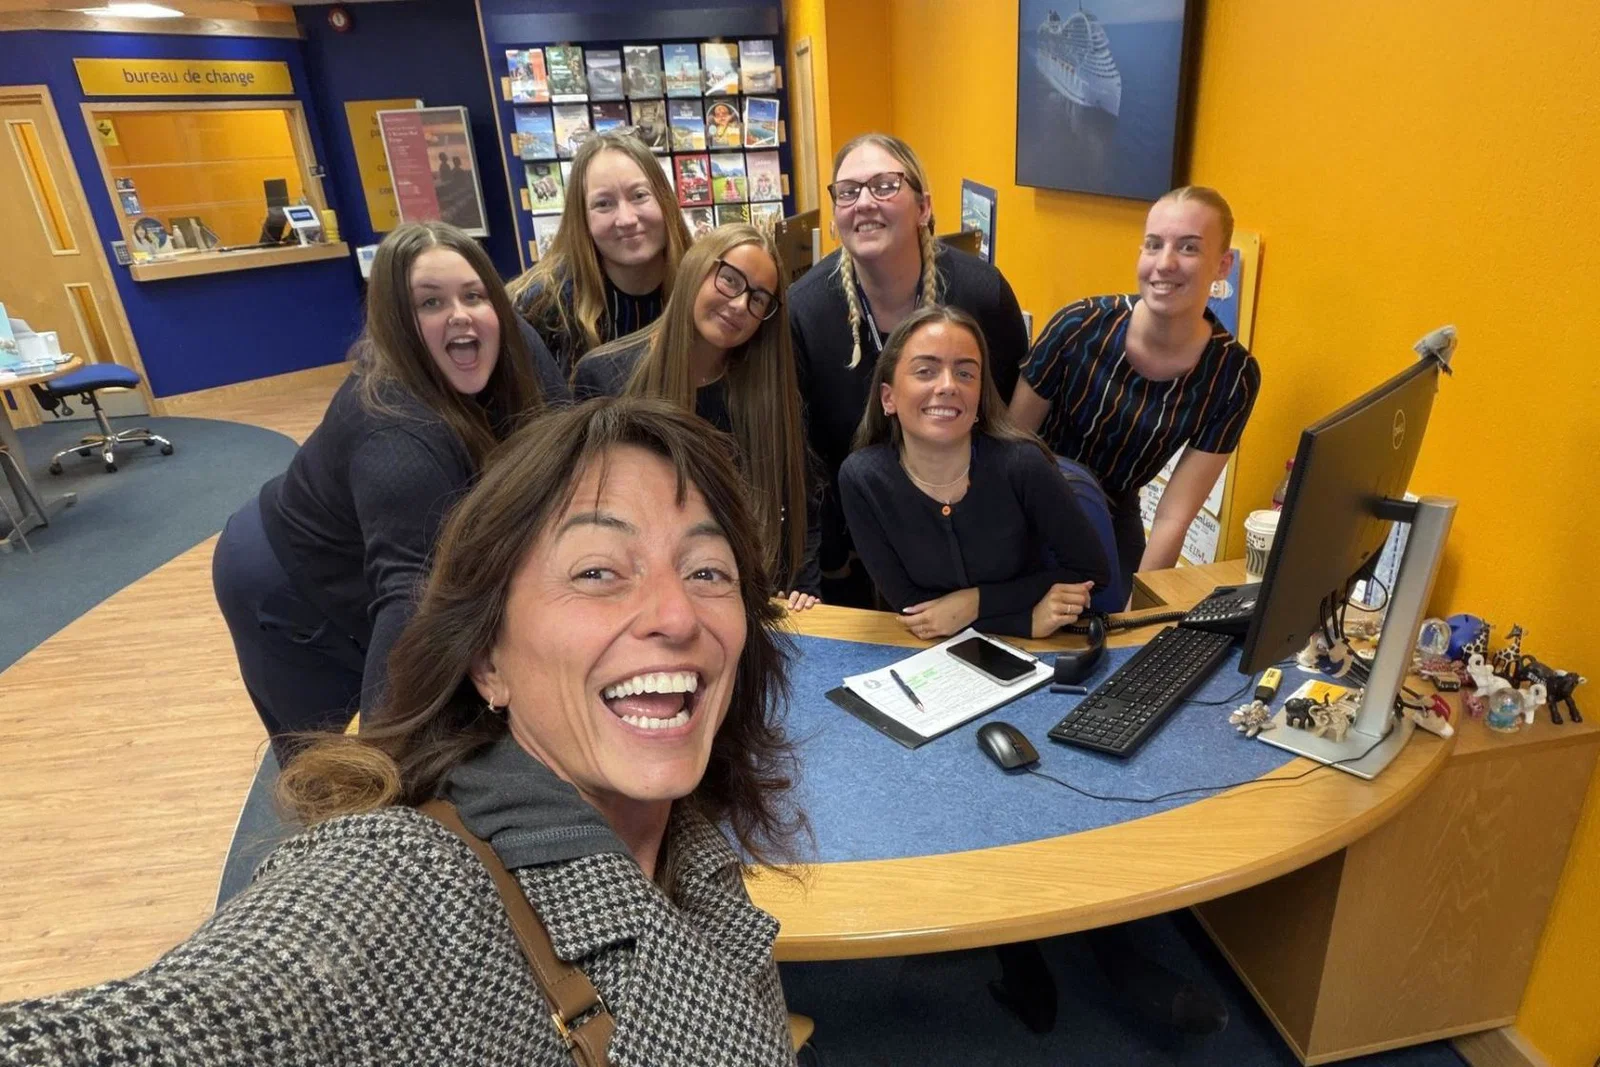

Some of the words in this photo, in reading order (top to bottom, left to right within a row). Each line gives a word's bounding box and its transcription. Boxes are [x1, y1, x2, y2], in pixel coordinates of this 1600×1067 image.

[122, 68, 179, 83] bureau
[183, 69, 201, 83] de
[205, 69, 255, 87] change
